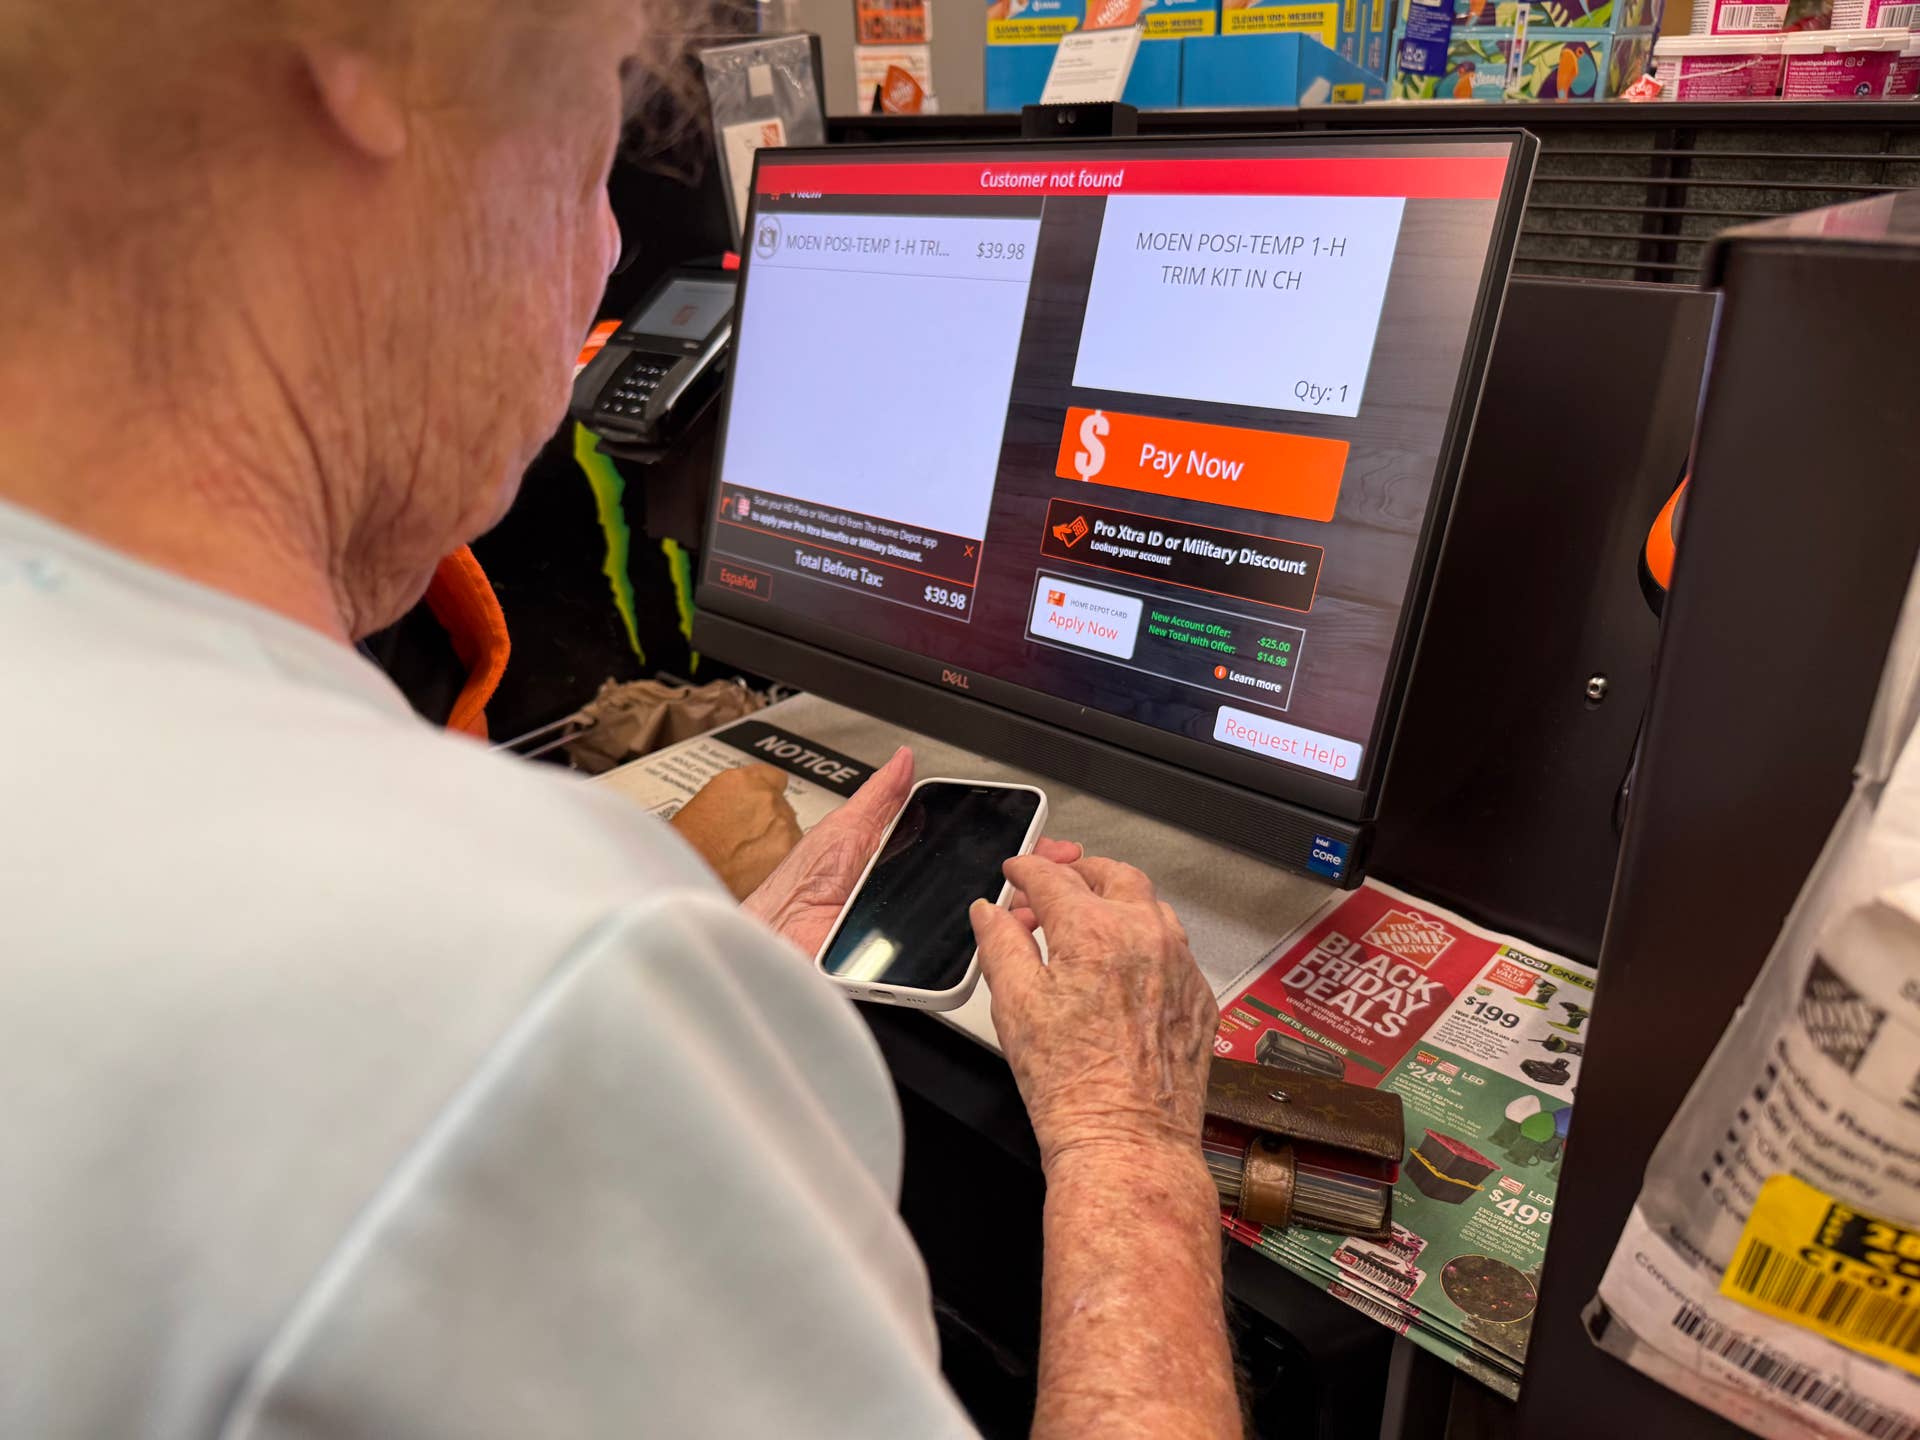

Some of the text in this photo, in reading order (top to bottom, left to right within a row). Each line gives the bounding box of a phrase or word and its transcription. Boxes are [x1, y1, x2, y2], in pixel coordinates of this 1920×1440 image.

[980, 170, 1124, 188] Customer not found
[786, 235, 951, 258] MOEN POSI-TEMP 1-H TRI...
[976, 241, 1026, 260] $39.98
[1136, 232, 1347, 257] MOEN POSI-TEMP 1-H
[1161, 265, 1302, 291] TRIM KIT IN CH
[1294, 380, 1349, 406] Qty: 1
[1139, 443, 1182, 478] Pay
[1186, 449, 1246, 482] Now
[751, 510, 923, 562] to apply your Pro Xtra benefits or Military Discount.
[768, 501, 783, 511] your
[794, 504, 809, 517] Pass
[809, 509, 817, 519] or
[817, 509, 838, 524] Virtual
[847, 516, 864, 530] from
[863, 520, 877, 534] The
[877, 525, 899, 539] Home
[899, 528, 922, 545] Depot
[922, 536, 939, 550] app
[1090, 540, 1172, 566] Lookup your account
[1094, 519, 1308, 577] Pro Xtra ID or Military Discount
[719, 567, 758, 590] Español
[794, 549, 884, 588] Total Before Tax:
[923, 585, 968, 611] $39.98
[1070, 599, 1129, 620] HOME DEPOT CARD
[1048, 611, 1119, 640] Apply Now
[1151, 610, 1232, 639] New Account Offer:
[1148, 624, 1237, 655] New Total with Offer:
[1256, 636, 1291, 653] -$25.00
[1256, 651, 1288, 668] $14.98
[942, 669, 969, 689] DELL
[1228, 670, 1282, 693] Learn more
[1225, 718, 1348, 772] Request Help
[754, 734, 861, 784] NOTICE
[1315, 837, 1330, 848] intel
[1312, 848, 1342, 866] CORE
[1369, 930, 1448, 946] HOME
[1316, 931, 1446, 1002] BLACK
[1508, 949, 1549, 971] RYOBI
[1299, 950, 1430, 1018] FRIDAY
[1280, 964, 1409, 1038] DEALS
[1303, 998, 1343, 1021] November
[1463, 995, 1520, 1029] $199
[1277, 1012, 1302, 1030] GIFTS
[1302, 1026, 1319, 1040] FOR
[1319, 1035, 1349, 1056] DOERS
[1286, 996, 1375, 1046] WHILE SUPPLIES LAST
[1527, 1190, 1553, 1206] LED
[1478, 1206, 1514, 1226] EXCLUSIVE
[1498, 1228, 1531, 1247] Christmas
